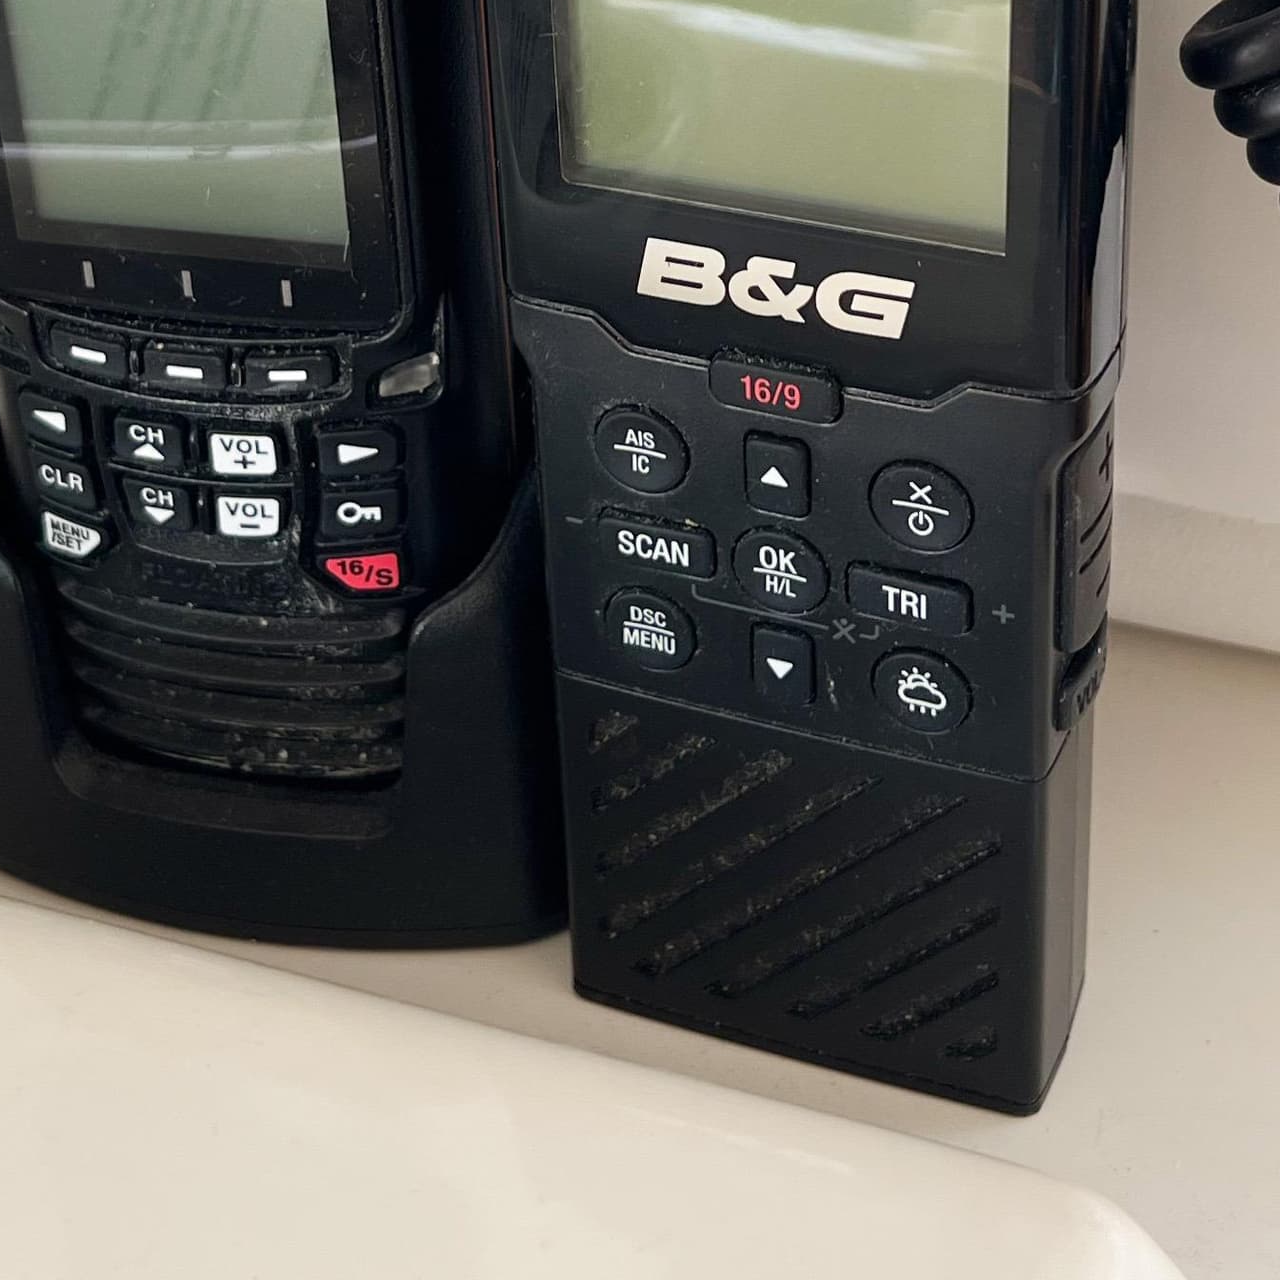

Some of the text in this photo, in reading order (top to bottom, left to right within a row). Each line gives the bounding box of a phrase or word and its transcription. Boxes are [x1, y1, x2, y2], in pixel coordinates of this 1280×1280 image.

[635, 236, 916, 341] B&G
[740, 374, 801, 411] 16/9
[128, 423, 165, 446] CH
[218, 437, 269, 456] VOL
[623, 427, 656, 449] AIS
[631, 454, 651, 475] IC
[37, 463, 85, 494] CLR
[140, 487, 175, 508] CH
[223, 501, 275, 520] VOL
[50, 519, 91, 542] MENU
[617, 529, 691, 567] SCAN
[758, 545, 797, 575] OK
[336, 558, 395, 588] 16/S
[764, 574, 798, 599] H/L
[881, 584, 928, 620] TRI
[629, 605, 668, 629] DSC
[622, 630, 677, 656] MENU
